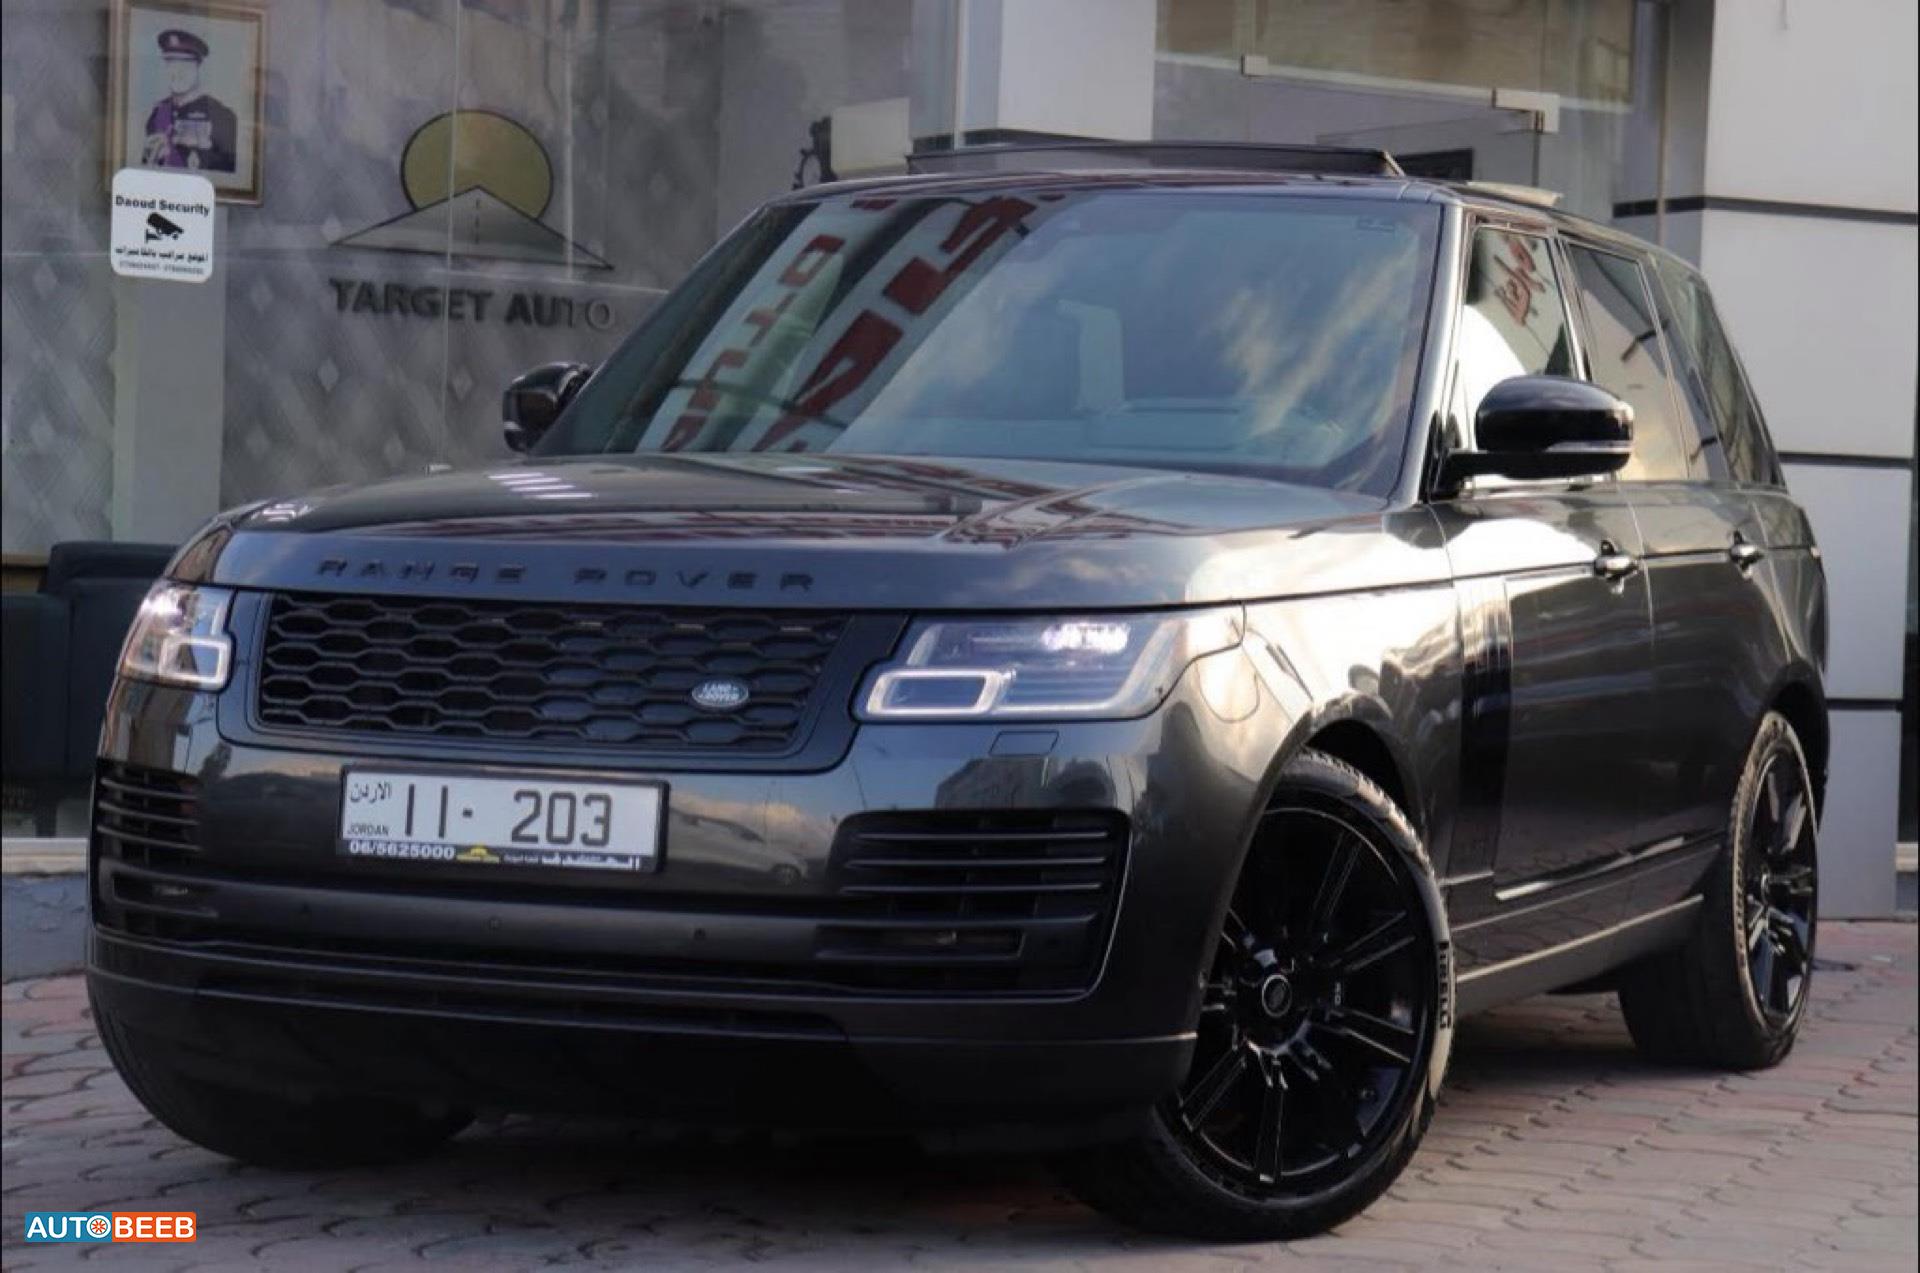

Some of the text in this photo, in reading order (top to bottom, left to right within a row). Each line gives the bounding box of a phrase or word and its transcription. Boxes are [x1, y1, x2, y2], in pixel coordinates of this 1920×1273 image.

[115, 195, 209, 217] Daoud Security
[329, 277, 612, 331] TARGET AUTO
[317, 557, 814, 591] RANGE ROVER
[347, 824, 389, 836] JORDAN
[511, 789, 612, 847] 203
[350, 839, 455, 860] 06/5625000
